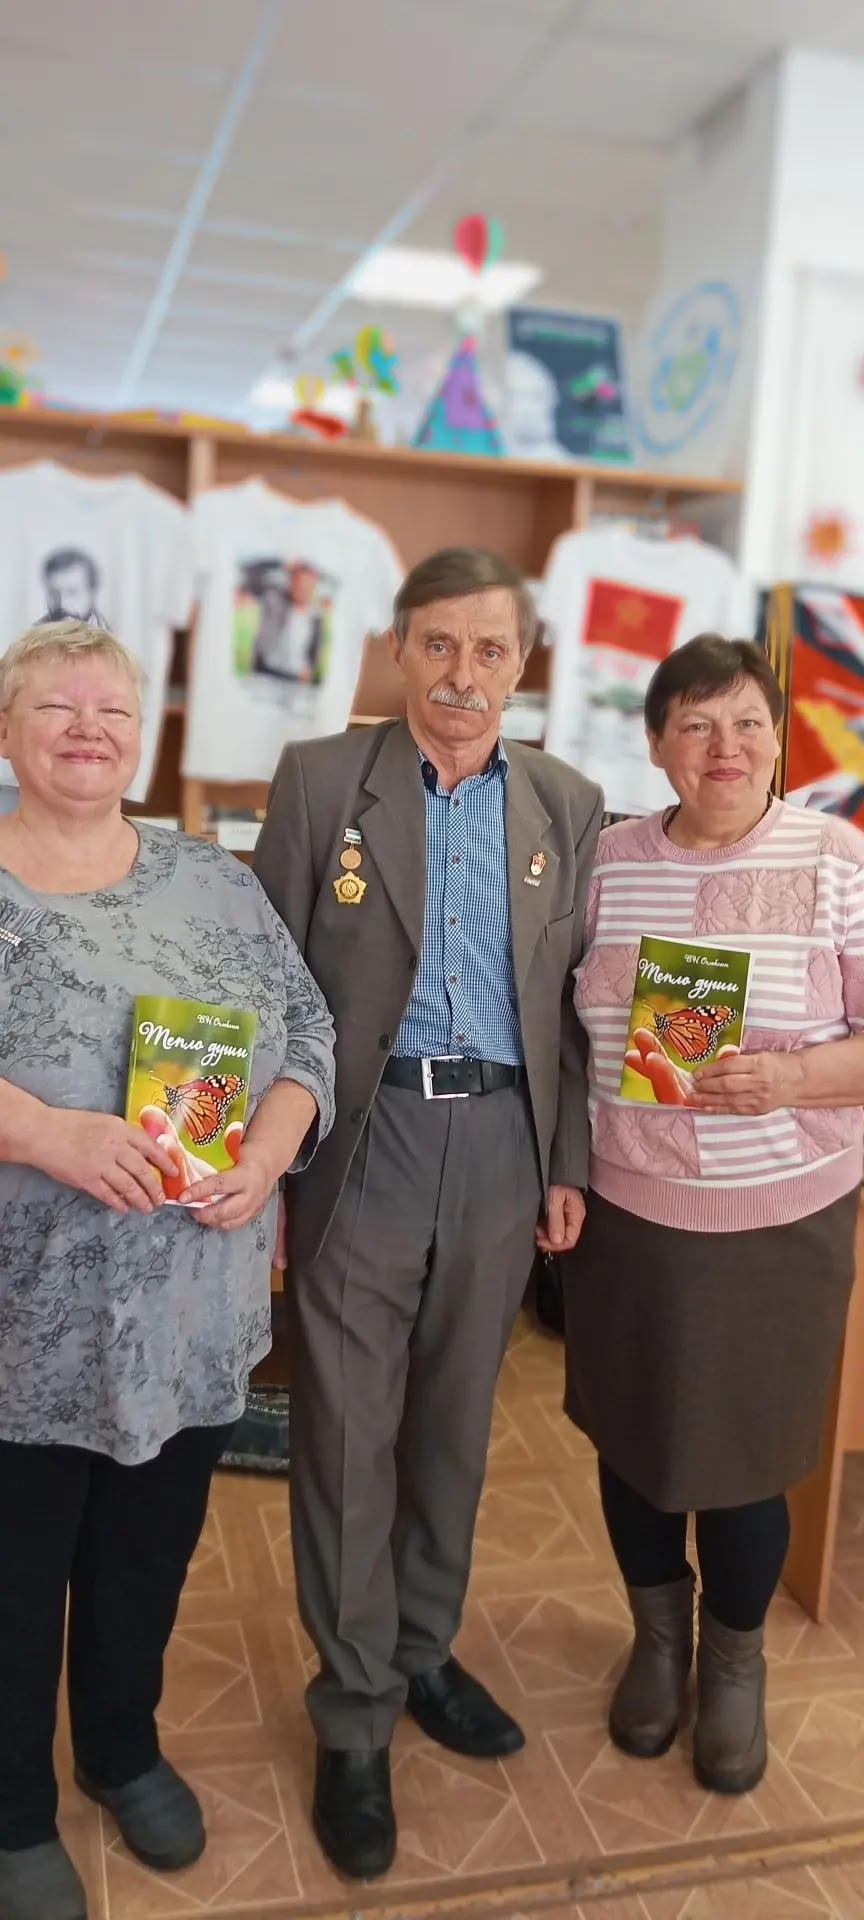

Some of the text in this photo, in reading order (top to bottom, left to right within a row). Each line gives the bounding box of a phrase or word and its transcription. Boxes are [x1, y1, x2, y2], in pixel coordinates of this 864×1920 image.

[639, 958, 739, 999] Тепло души
[139, 1021, 248, 1067] Тепло души
